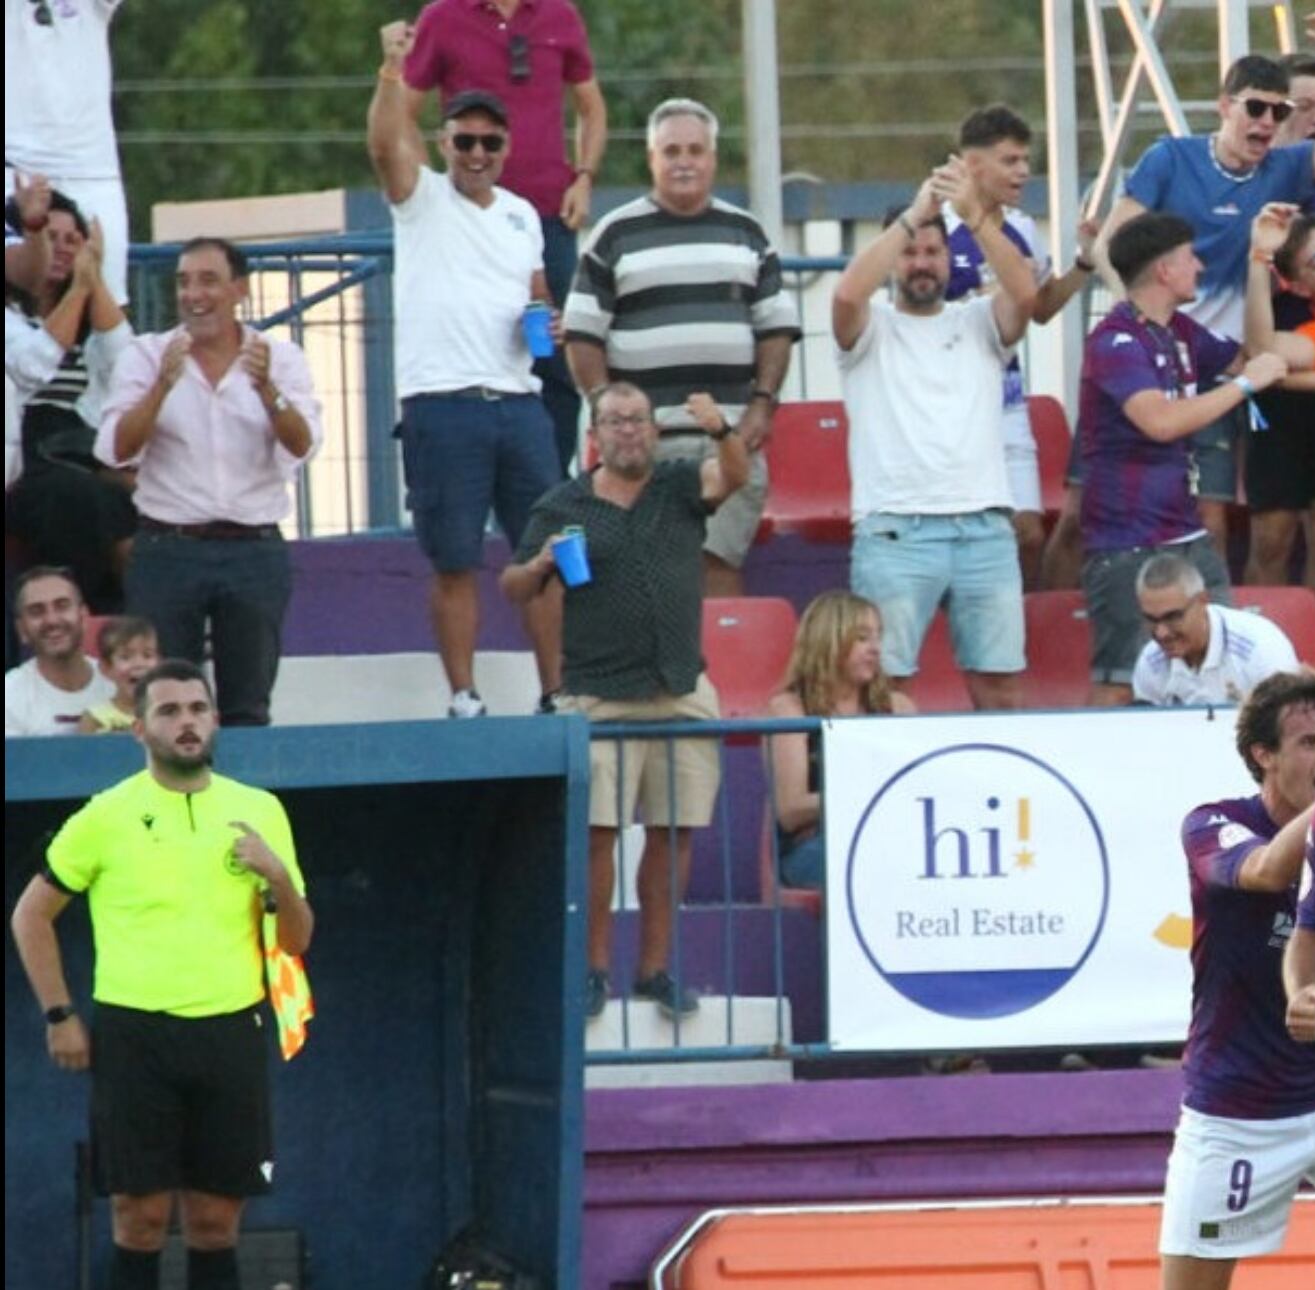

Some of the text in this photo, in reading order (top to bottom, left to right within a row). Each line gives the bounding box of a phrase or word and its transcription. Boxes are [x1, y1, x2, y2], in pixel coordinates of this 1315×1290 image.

[915, 796, 1035, 880] hi!
[895, 908, 1065, 939] Real Estate
[1226, 1158, 1255, 1213] 9
